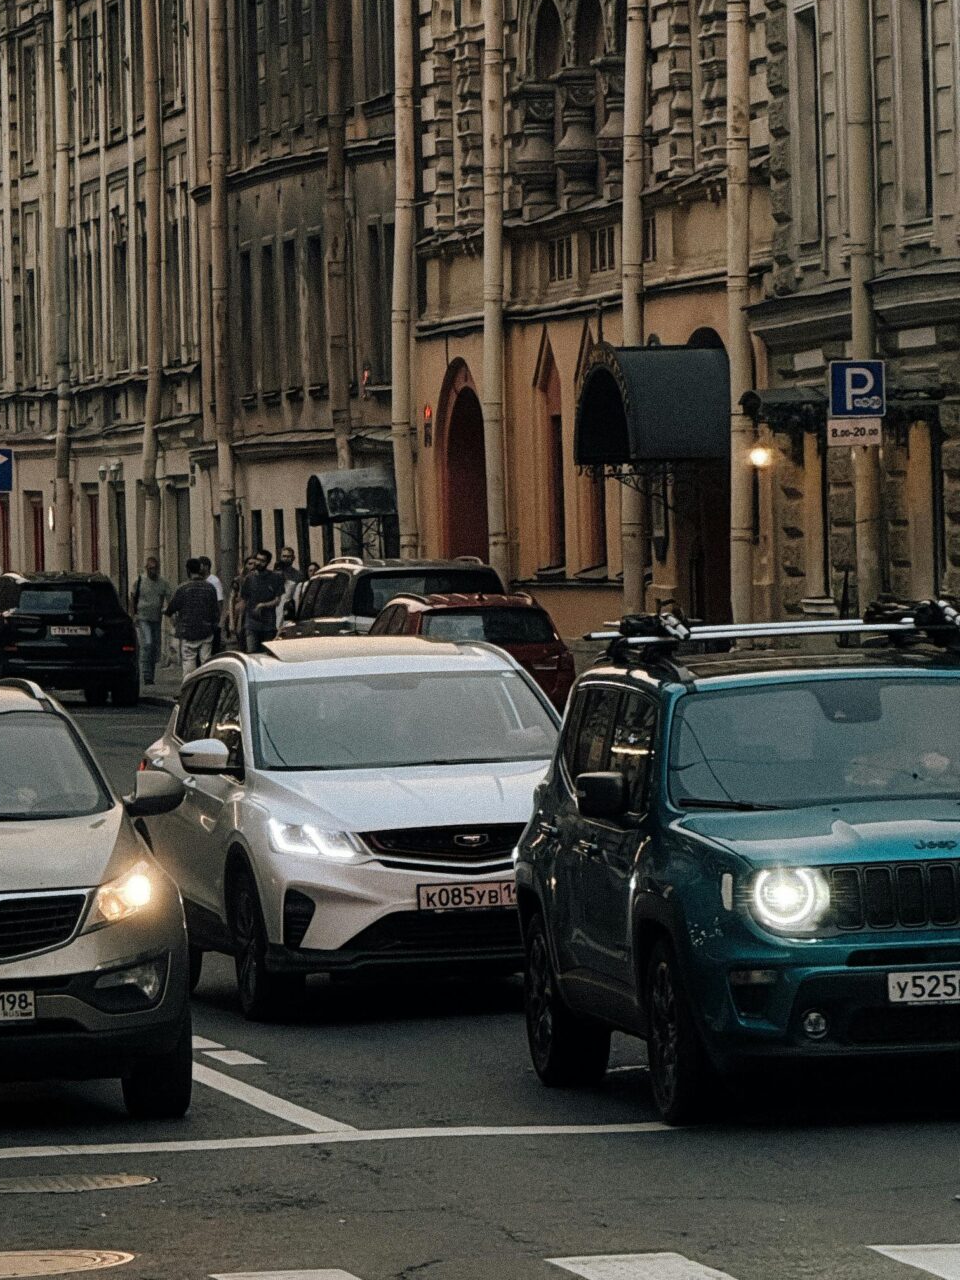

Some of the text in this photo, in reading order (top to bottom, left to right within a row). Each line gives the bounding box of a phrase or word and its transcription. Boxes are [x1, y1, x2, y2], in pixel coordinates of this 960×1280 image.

[845, 367, 874, 410] P
[914, 840, 957, 850] Jeep
[426, 887, 499, 908] К085УВ
[896, 973, 960, 999] У525
